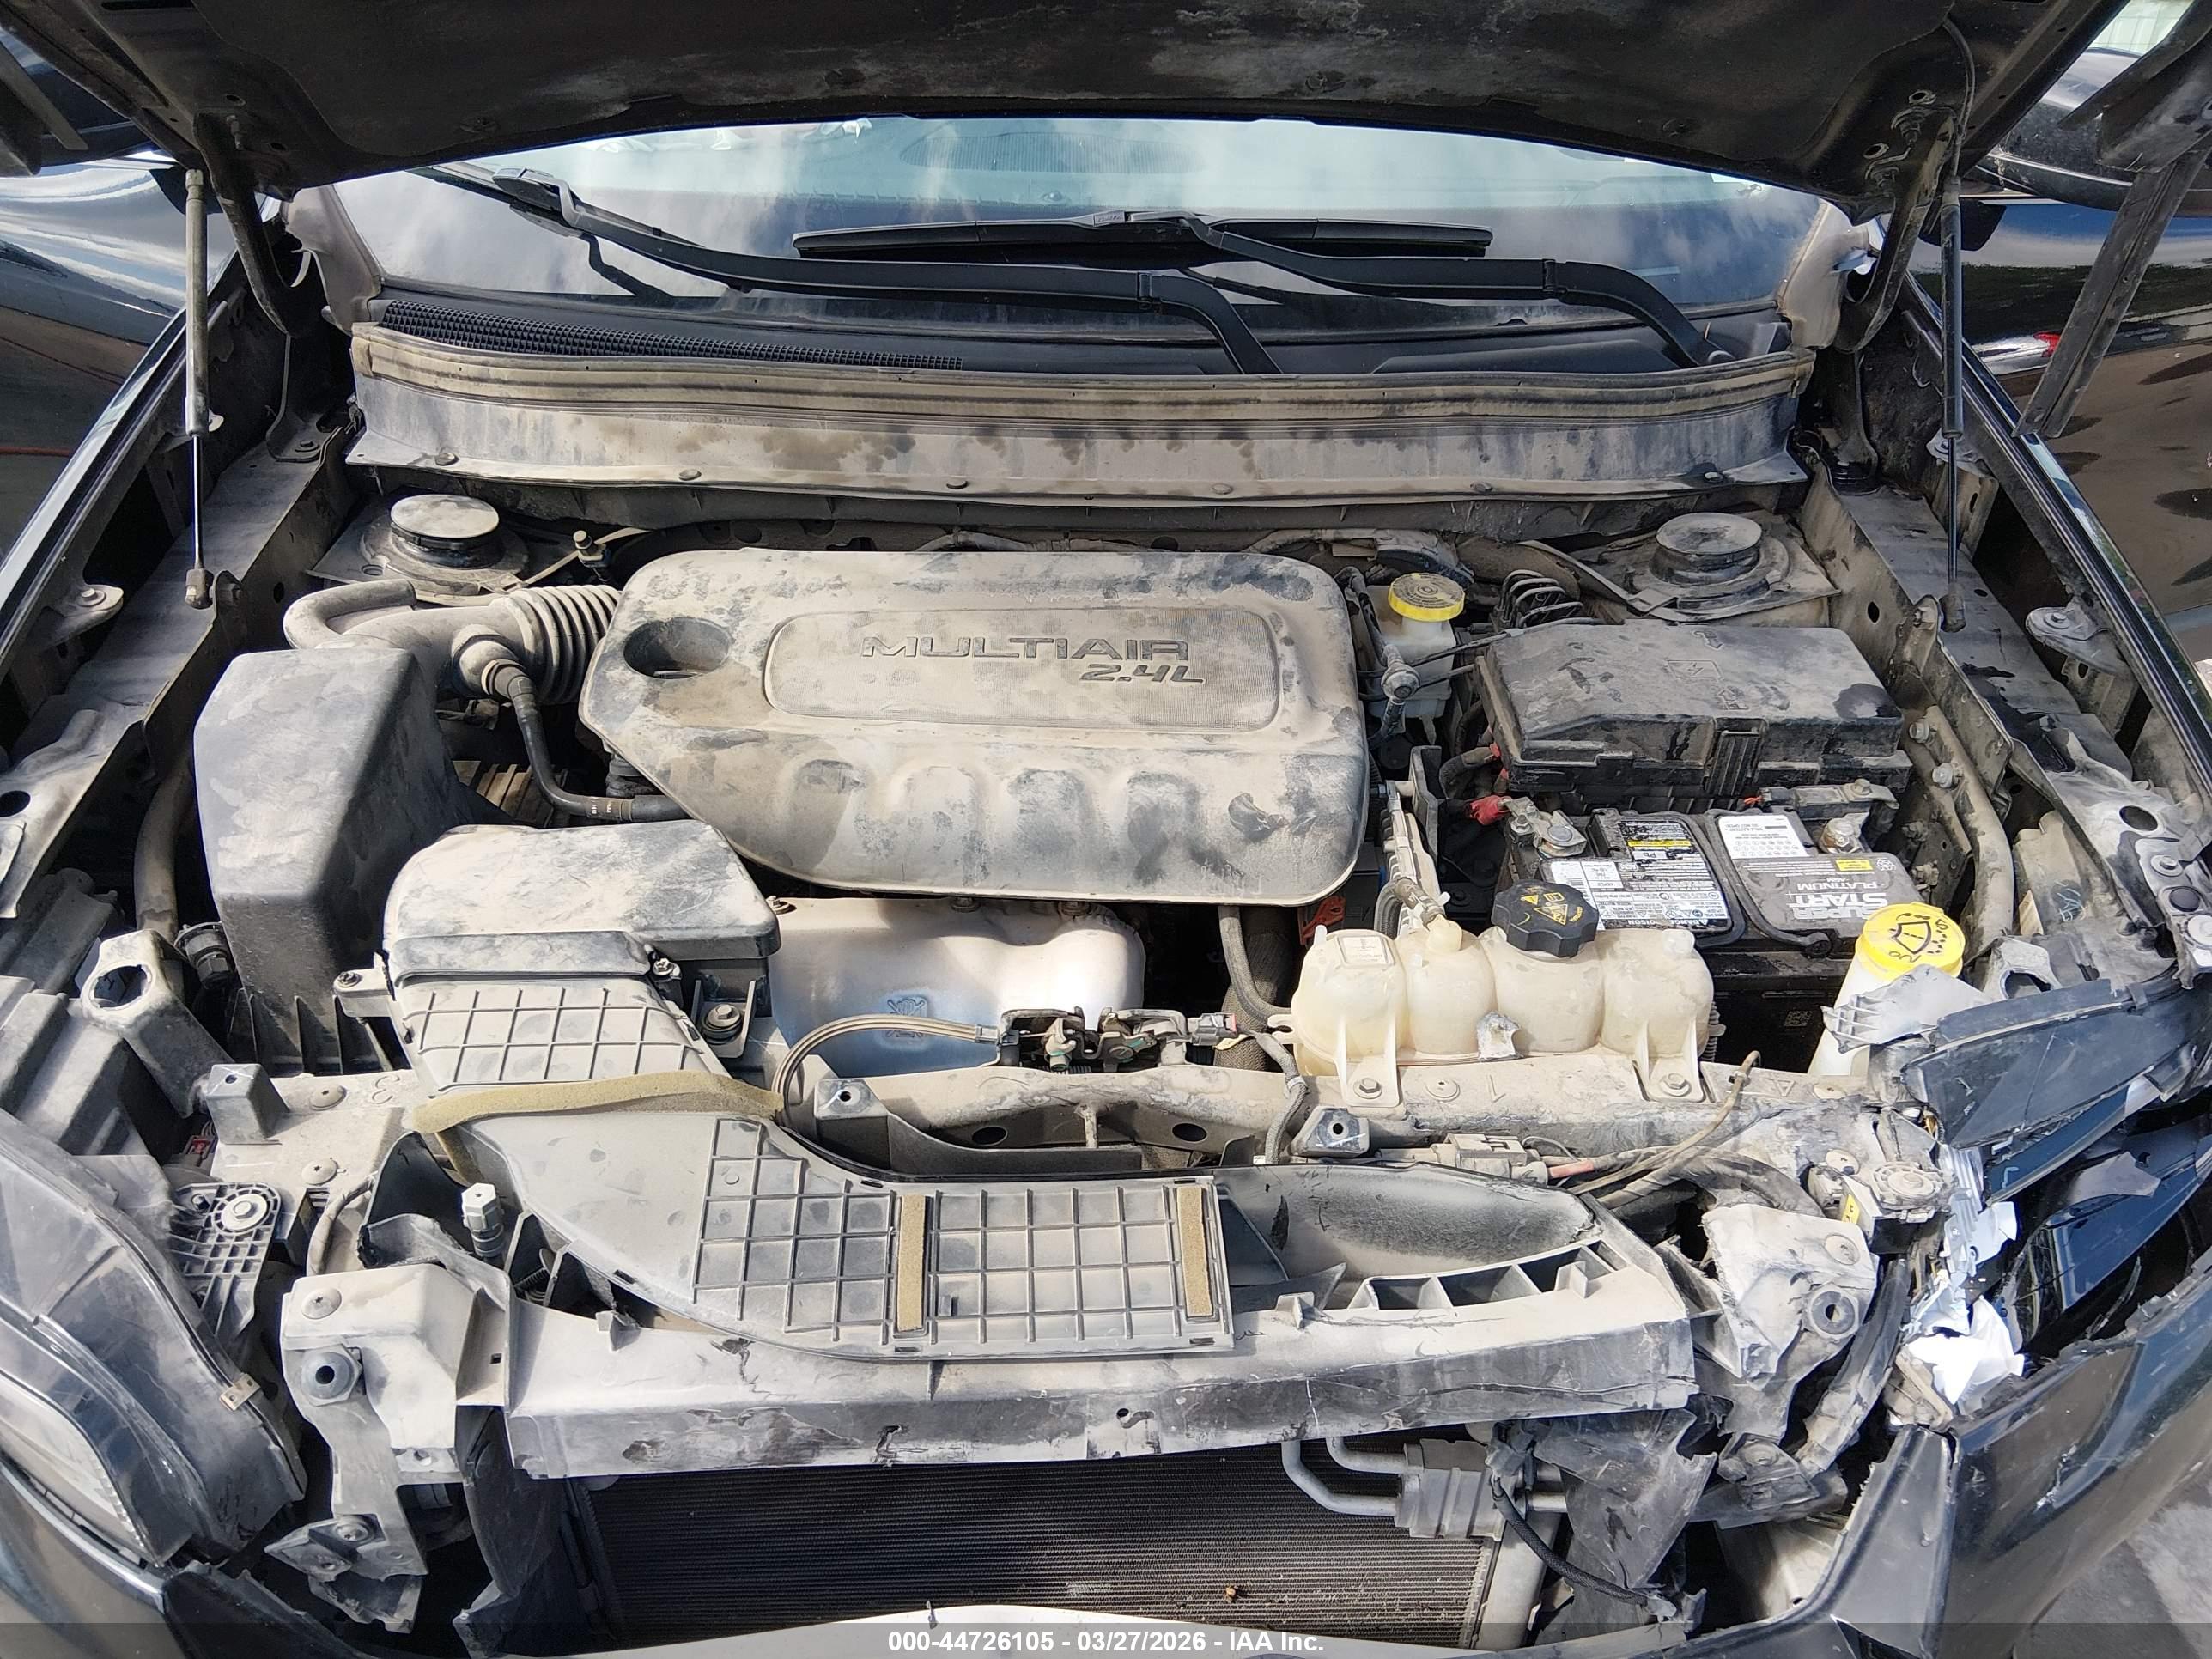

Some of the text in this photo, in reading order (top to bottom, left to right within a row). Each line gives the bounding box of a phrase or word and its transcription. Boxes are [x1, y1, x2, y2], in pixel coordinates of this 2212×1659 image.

[860, 636, 1190, 662] MULTIAIR
[1079, 663, 1204, 684] 2.4L
[1797, 881, 1878, 890] PLATINUM
[1786, 893, 1888, 908] START
[1792, 906, 1878, 920] SUPER
